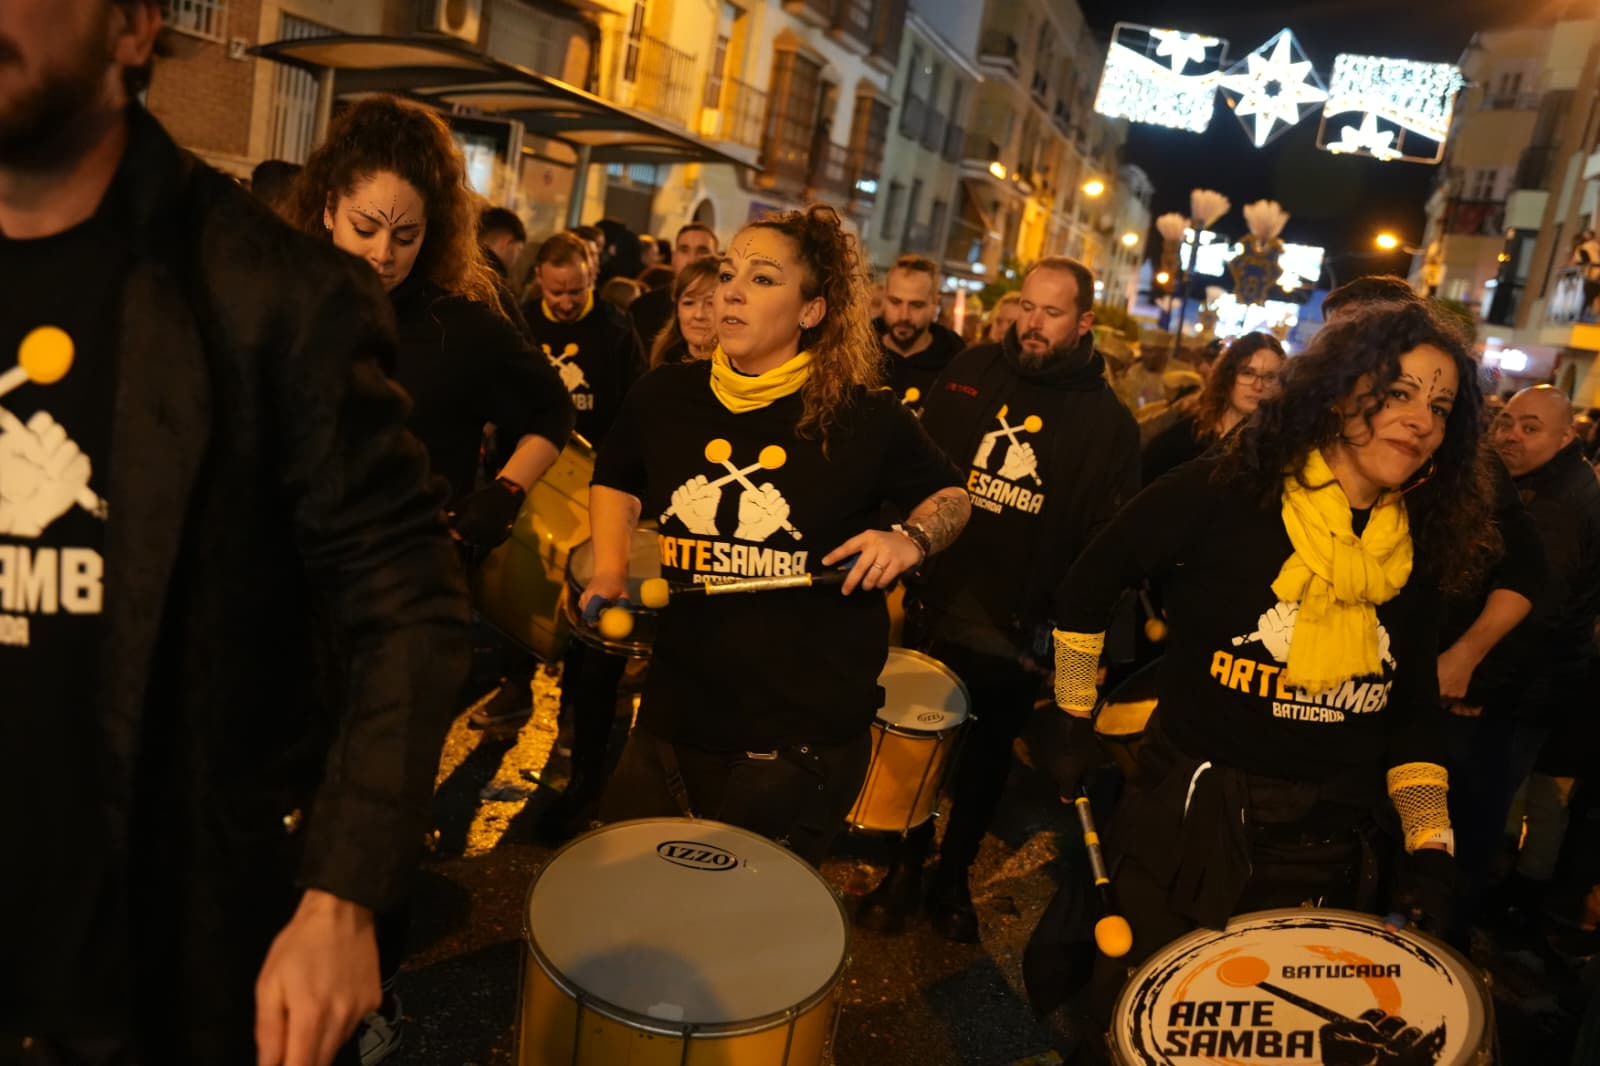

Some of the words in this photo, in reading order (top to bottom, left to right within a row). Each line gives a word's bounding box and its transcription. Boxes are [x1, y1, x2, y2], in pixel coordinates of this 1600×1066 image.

[1272, 702, 1345, 723] BATUCADA
[664, 845, 730, 865] IZZO
[1281, 964, 1401, 979] BATUCADA
[1167, 1001, 1274, 1027] ARTE
[1163, 1030, 1314, 1059] SAMBA
